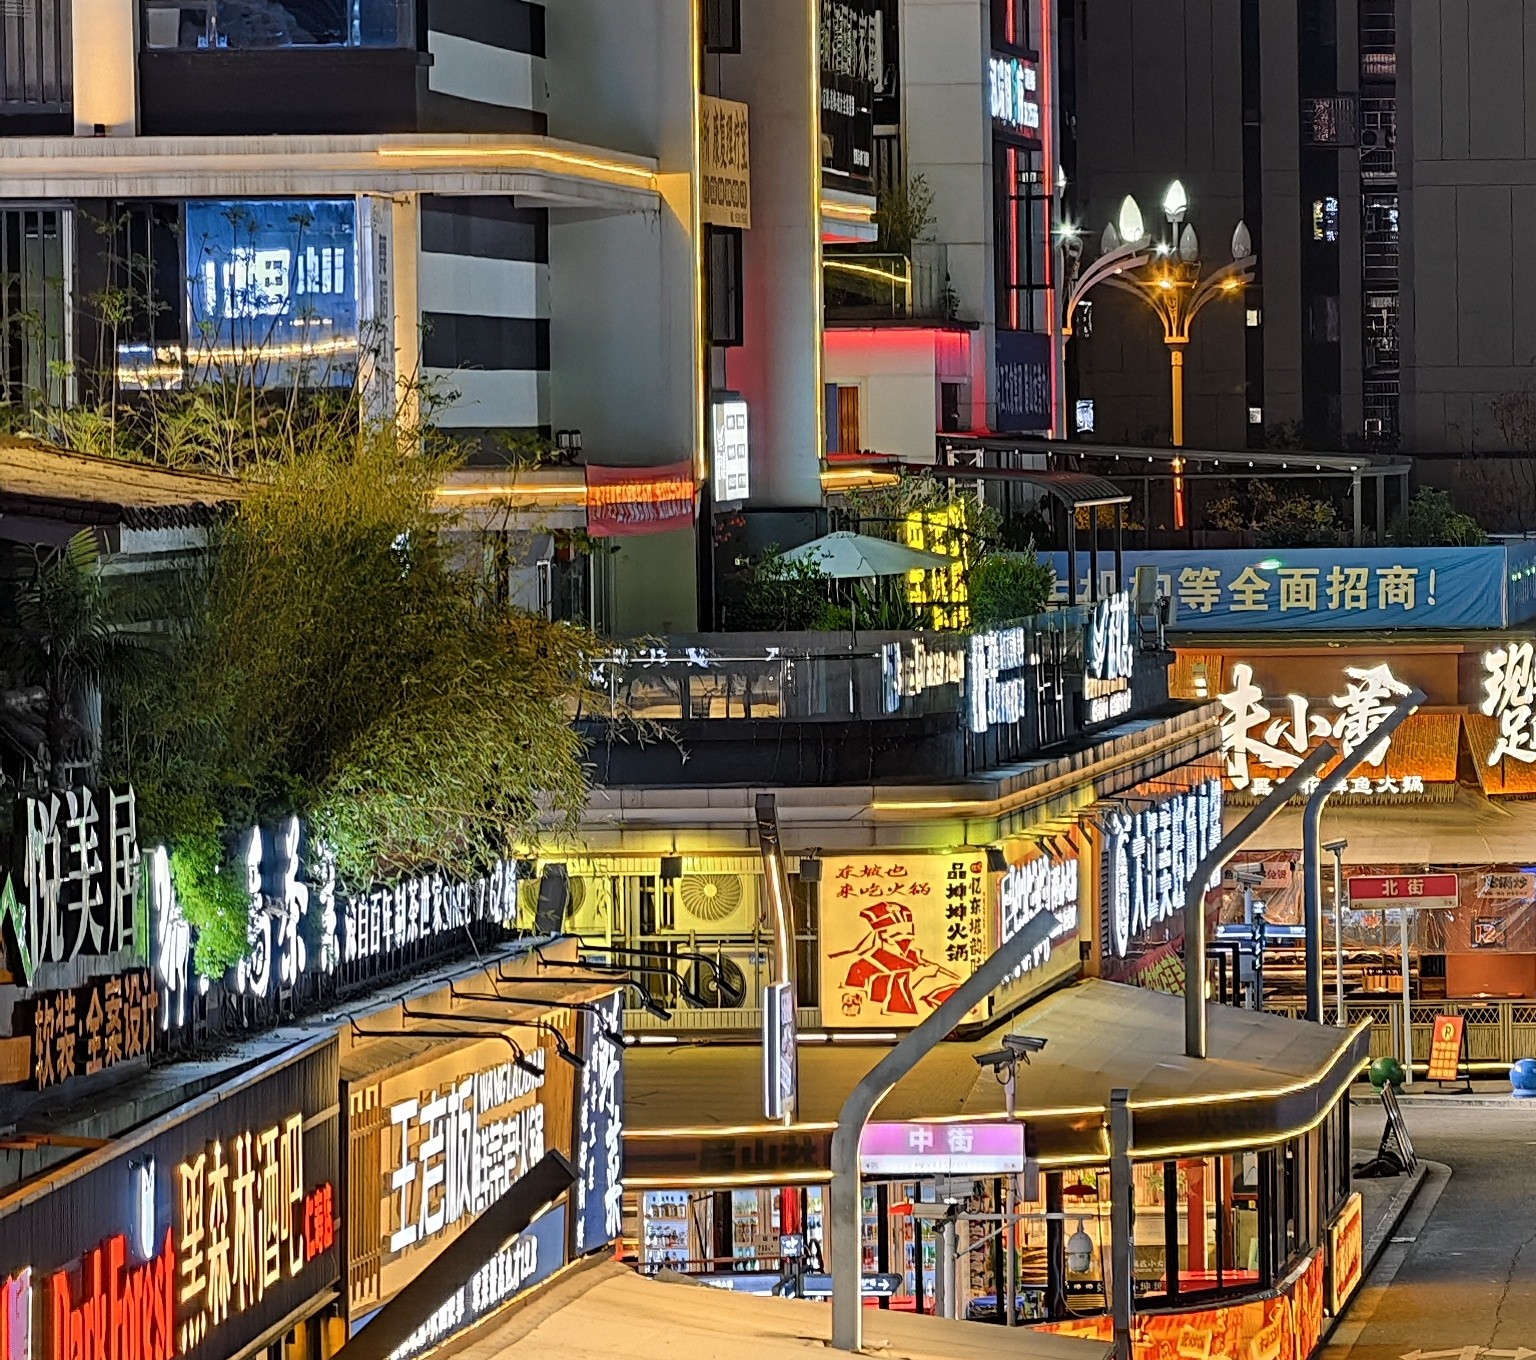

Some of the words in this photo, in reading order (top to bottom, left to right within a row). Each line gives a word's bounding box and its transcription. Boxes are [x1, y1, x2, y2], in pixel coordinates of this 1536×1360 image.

[24, 782, 141, 966] 悦美居
[836, 864, 908, 878] 东坡也
[836, 882, 931, 898] 来吃火锅
[1382, 879, 1425, 896] 北街
[909, 1126, 974, 1154] 中街
[390, 1075, 472, 1253] 王老板
[179, 1112, 303, 1355] 黑森林酒吧
